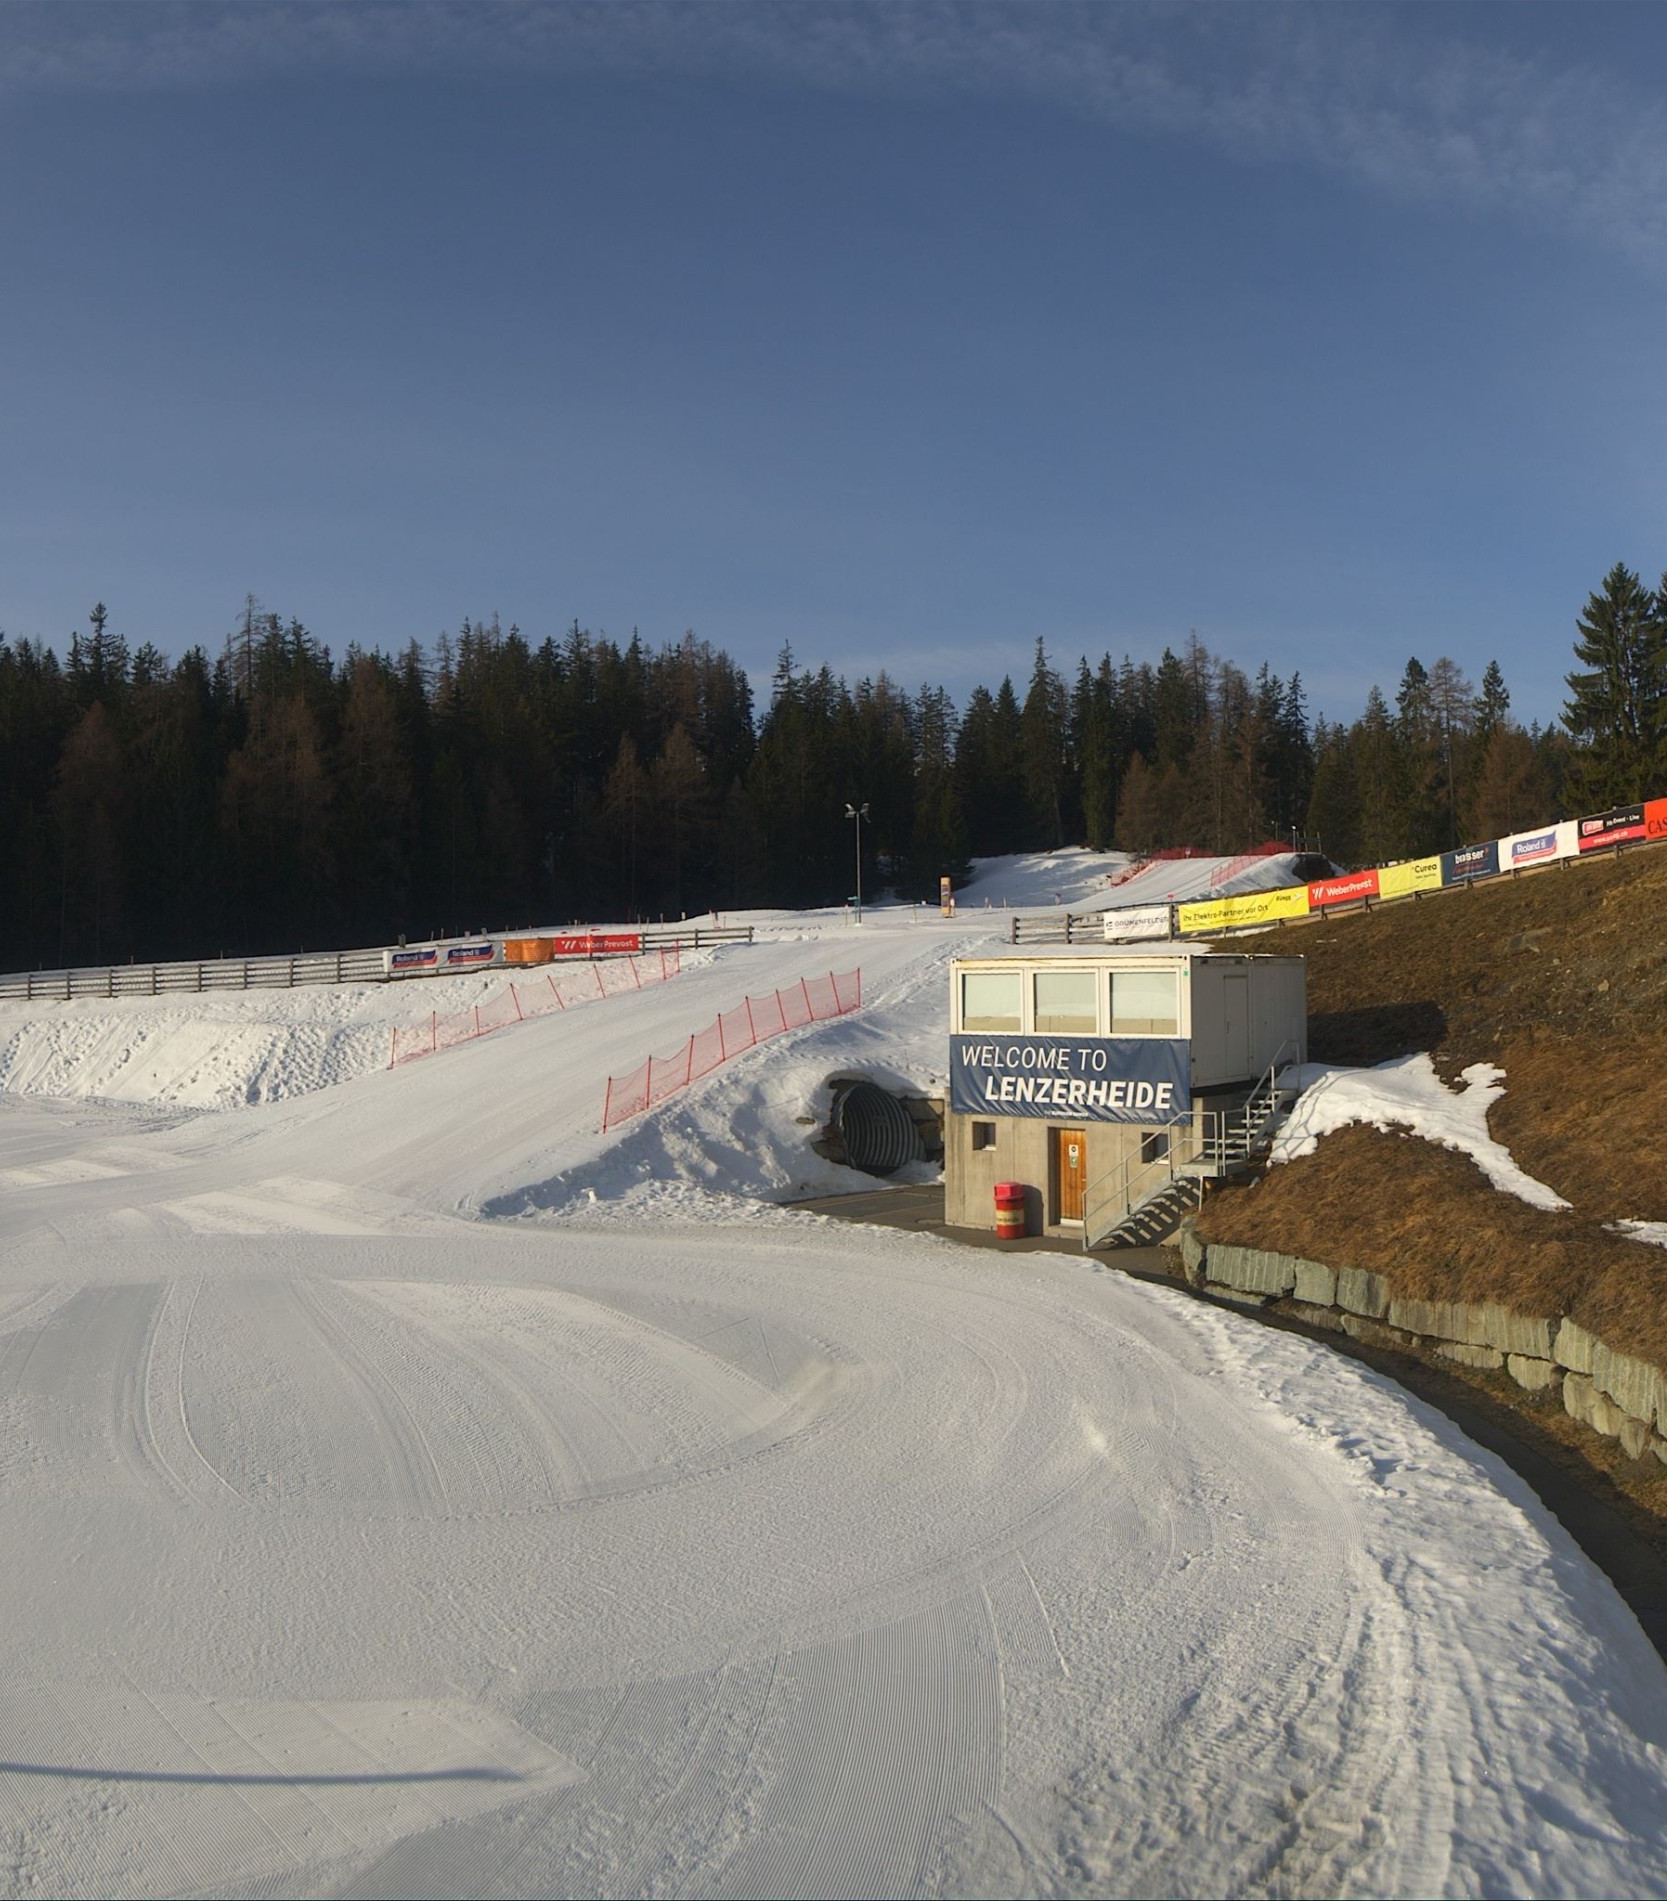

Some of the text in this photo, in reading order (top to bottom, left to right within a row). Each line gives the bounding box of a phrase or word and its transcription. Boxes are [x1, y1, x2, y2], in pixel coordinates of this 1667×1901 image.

[1517, 841, 1540, 854] Roland
[1415, 863, 1437, 874] Curea
[1257, 904, 1269, 913] Ort
[962, 1045, 1108, 1072] WELCOME TO
[985, 1075, 1174, 1110] LENZERHEIDE
